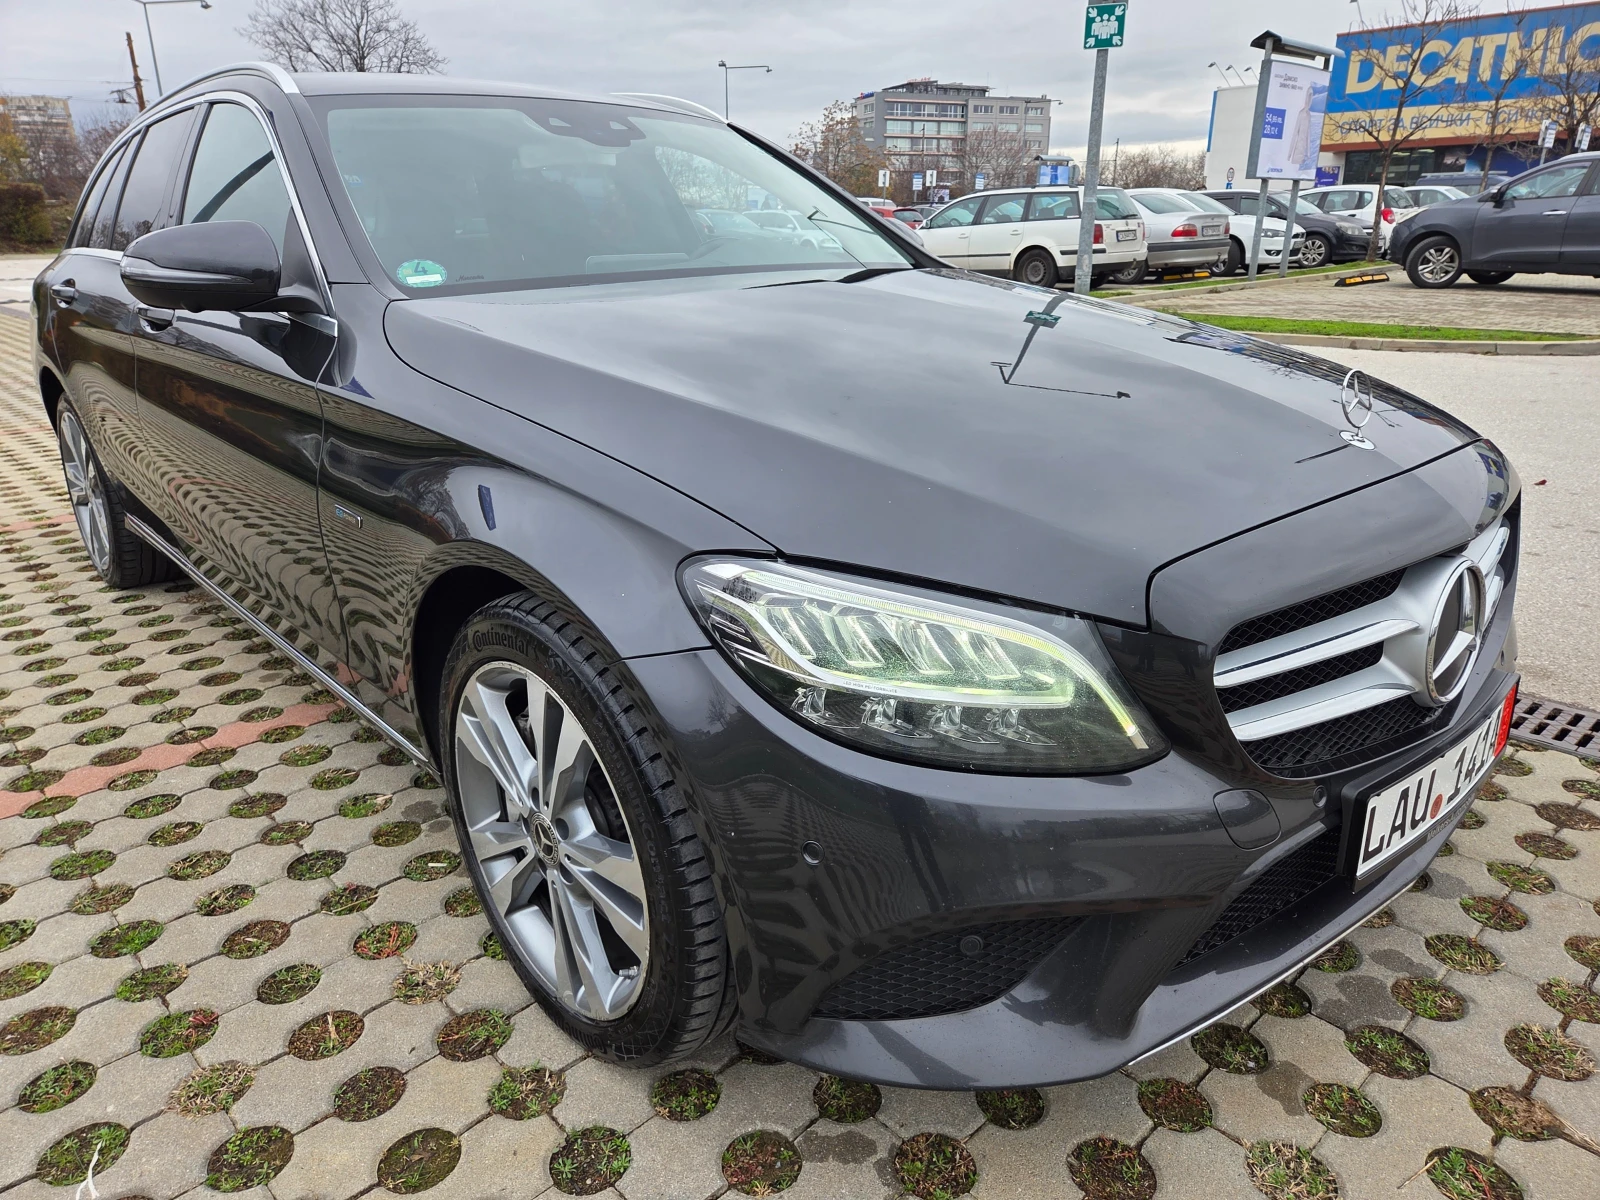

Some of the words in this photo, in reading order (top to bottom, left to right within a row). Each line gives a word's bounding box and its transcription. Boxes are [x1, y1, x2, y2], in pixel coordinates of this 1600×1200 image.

[413, 262, 428, 275] 4
[473, 626, 529, 657] Continental
[1362, 769, 1437, 864] LAU
